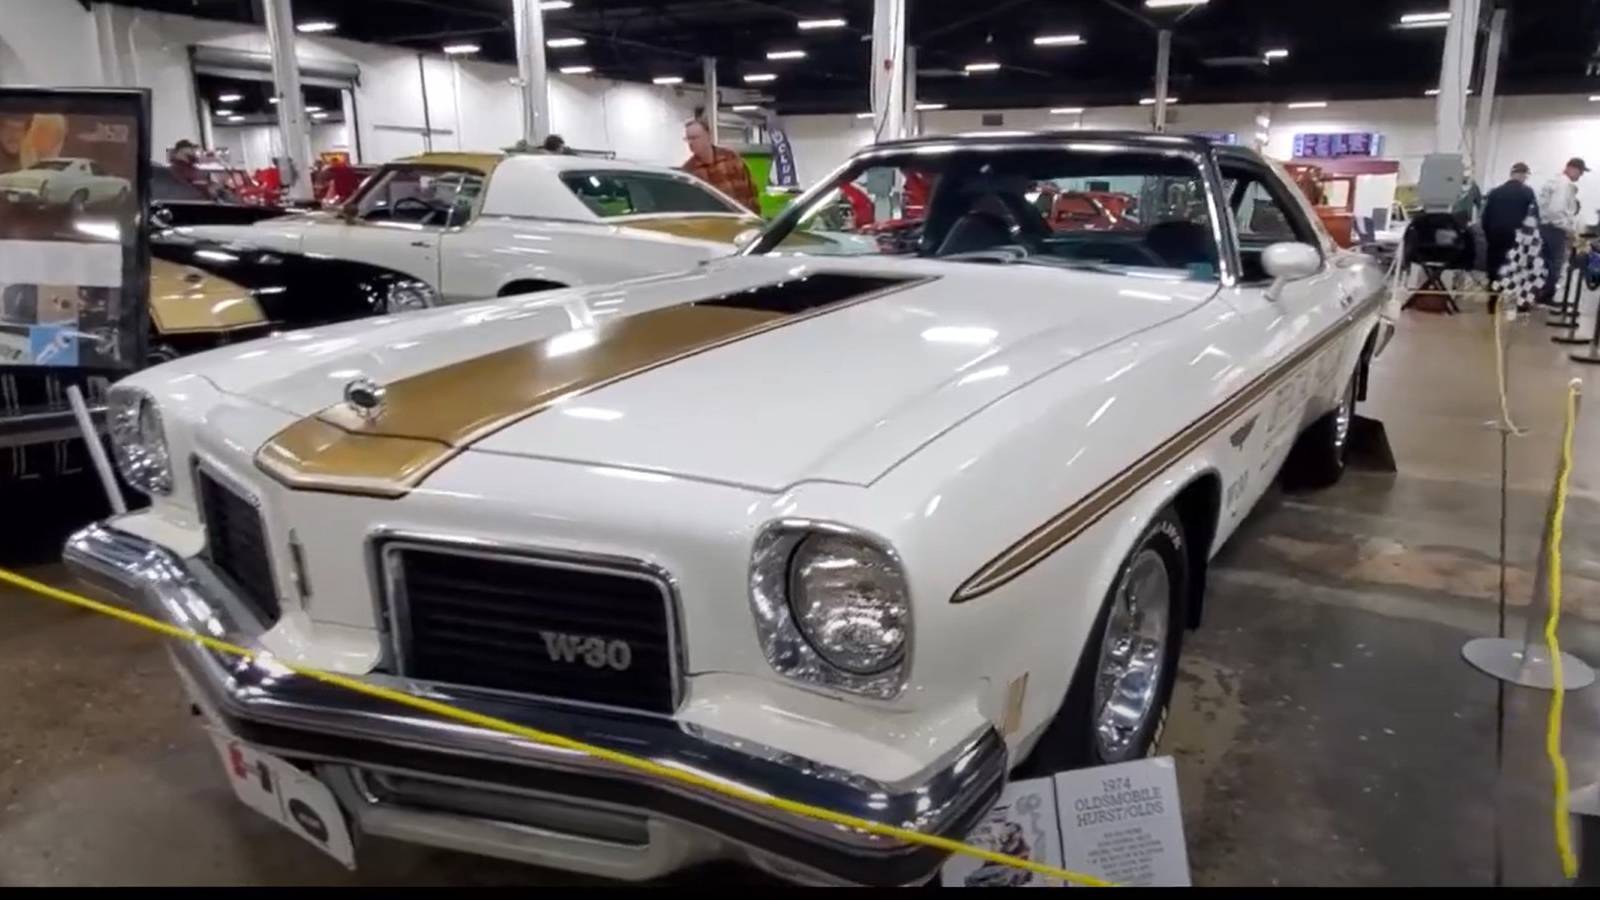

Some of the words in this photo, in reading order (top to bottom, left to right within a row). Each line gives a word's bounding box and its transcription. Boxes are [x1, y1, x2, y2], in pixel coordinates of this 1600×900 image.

[539, 631, 631, 670] W-30
[1102, 777, 1131, 792] 1974
[1074, 786, 1162, 812] OLDSMOBILE
[1076, 801, 1165, 827] HURST/OLDS
